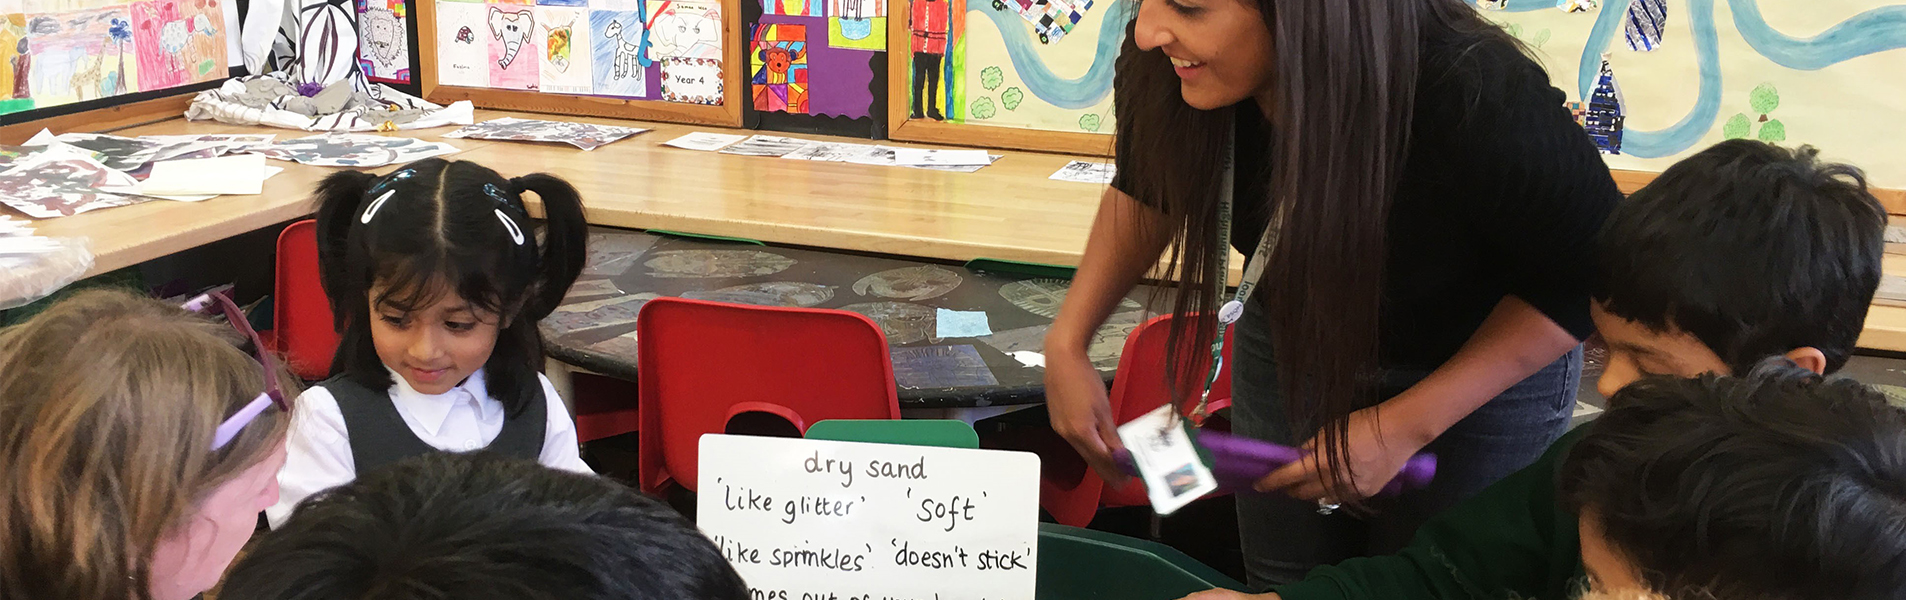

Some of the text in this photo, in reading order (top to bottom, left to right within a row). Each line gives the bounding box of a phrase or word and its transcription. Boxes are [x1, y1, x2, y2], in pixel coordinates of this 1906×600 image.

[675, 75, 705, 84] Year 4
[804, 450, 928, 488] dry sand
